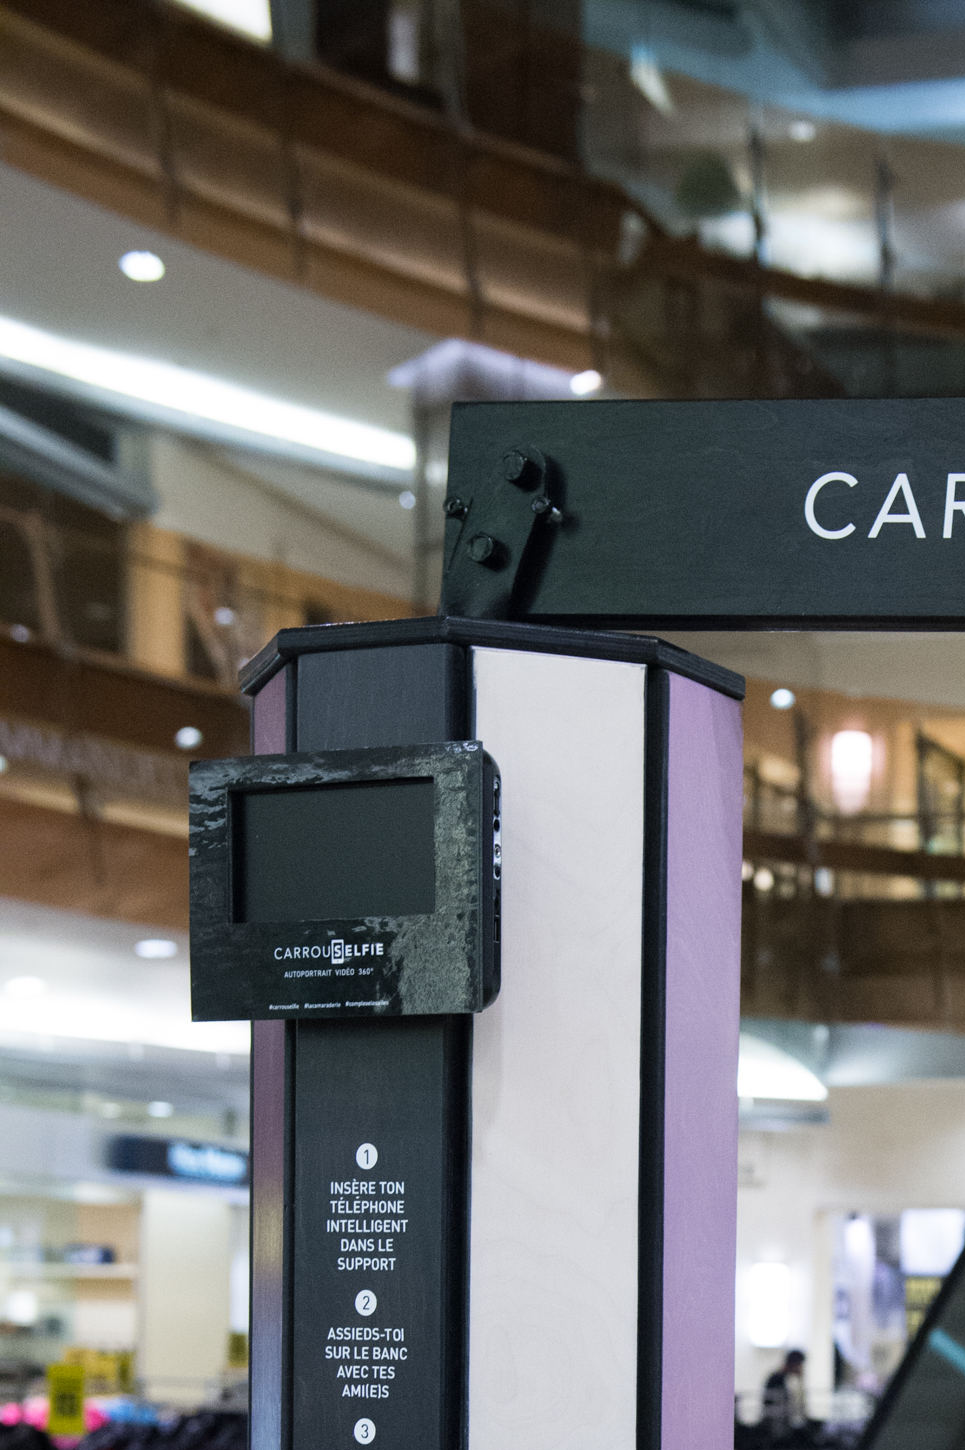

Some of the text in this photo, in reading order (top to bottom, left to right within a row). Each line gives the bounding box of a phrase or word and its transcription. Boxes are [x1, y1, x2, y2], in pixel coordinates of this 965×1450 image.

[274, 943, 384, 960] CARROUSELFIE
[284, 969, 332, 978] AUTOPORTRAIT
[335, 967, 355, 976] VIDÉO
[330, 1179, 405, 1195] INSÈRE TON
[330, 1196, 405, 1214] TÉLÉPHONE
[326, 1219, 408, 1233] INTELLIGENT
[340, 1238, 394, 1252] DANS LE
[337, 1257, 396, 1271] SUPPORT
[327, 1327, 404, 1342] ASSIEDS-TOI
[325, 1346, 408, 1360] SUR LE BANC
[336, 1365, 395, 1379] AVEC TES
[342, 1384, 390, 1399] AMI(E)S
